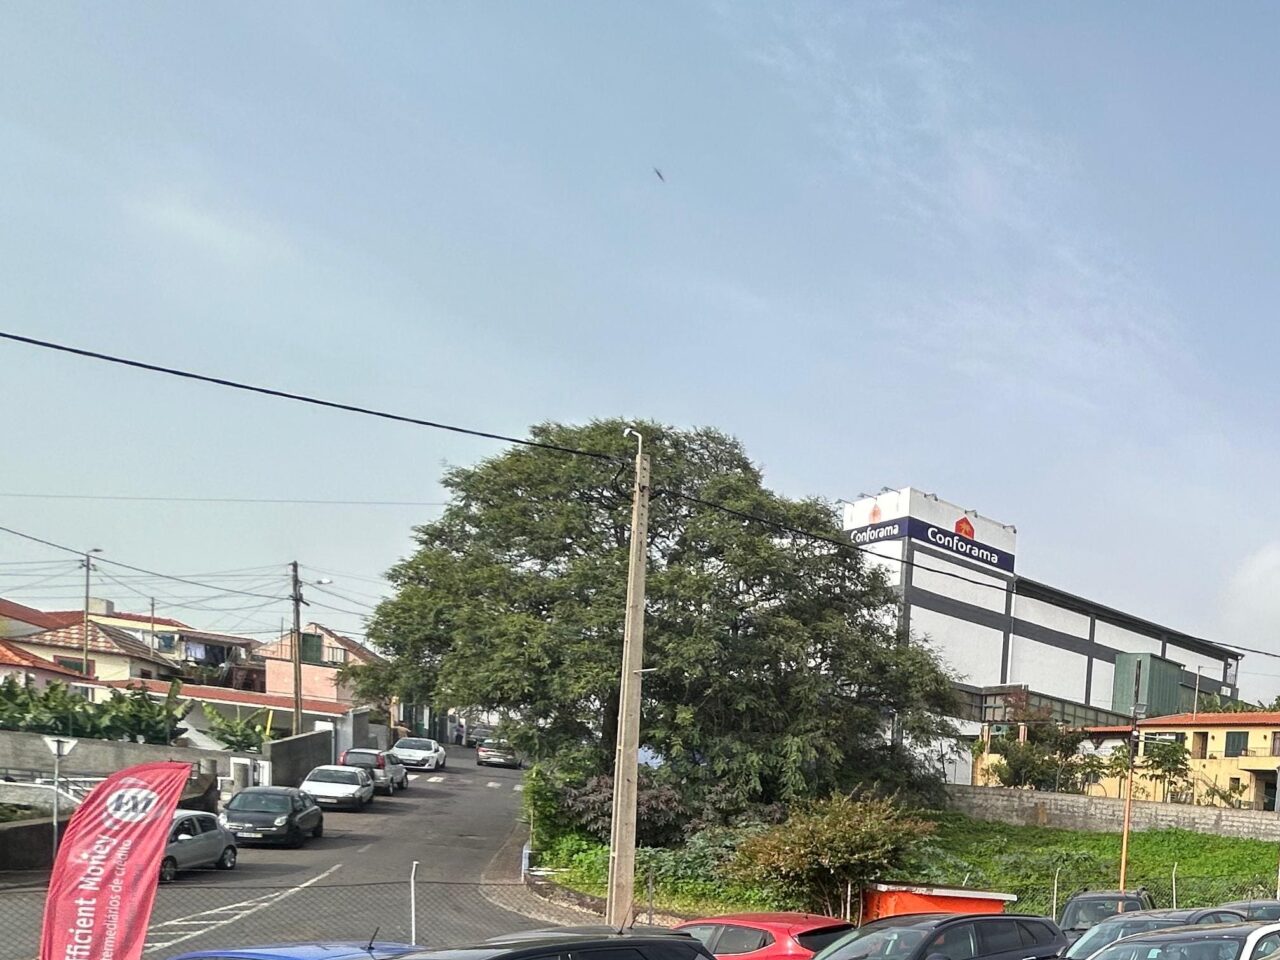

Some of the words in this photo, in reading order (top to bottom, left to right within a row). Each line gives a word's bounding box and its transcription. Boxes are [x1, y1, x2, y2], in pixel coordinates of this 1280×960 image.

[850, 523, 899, 544] Conforama
[927, 526, 999, 564] Conforama
[78, 834, 117, 892] Money
[113, 878, 124, 894] de
